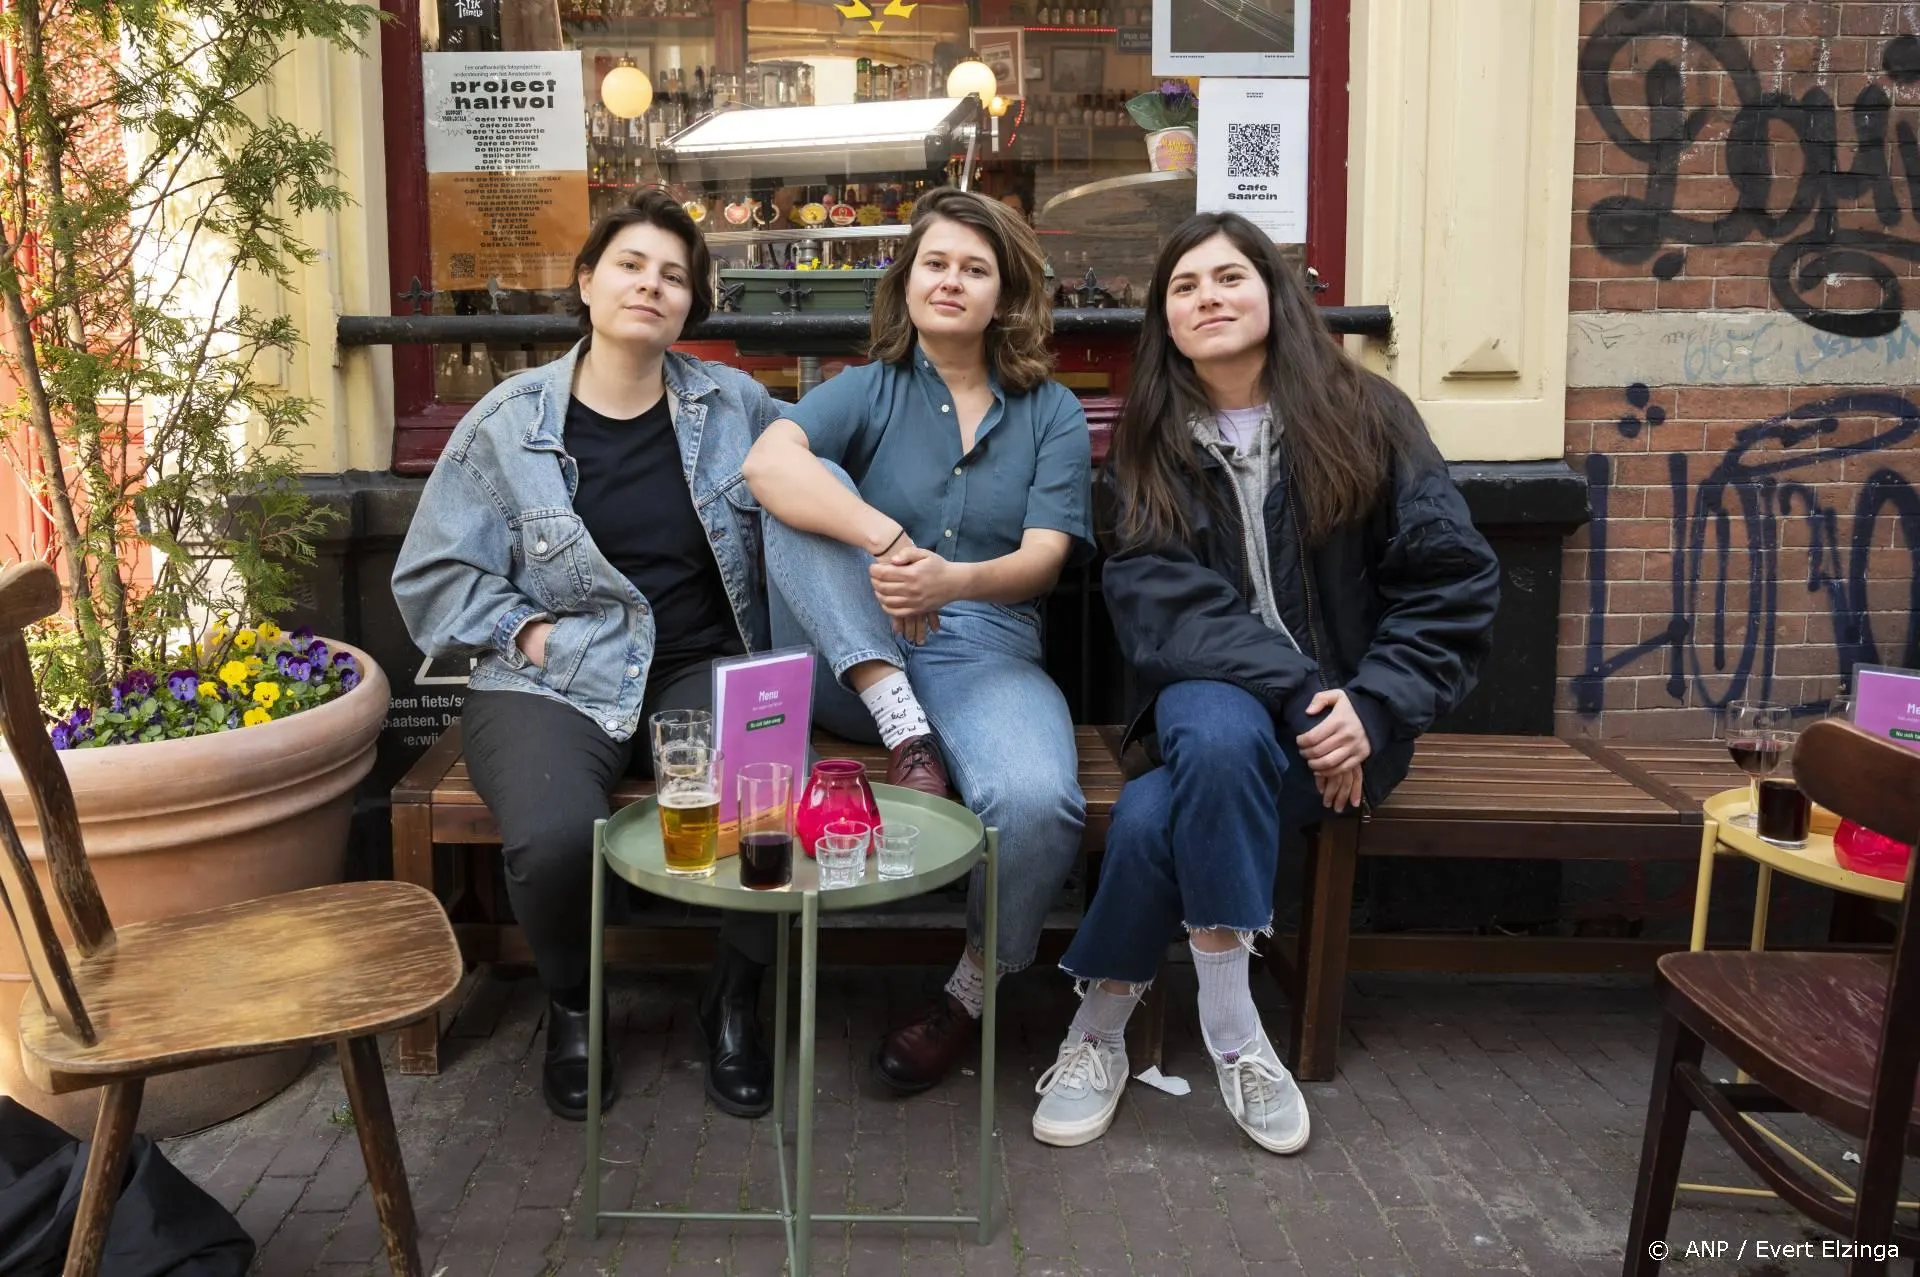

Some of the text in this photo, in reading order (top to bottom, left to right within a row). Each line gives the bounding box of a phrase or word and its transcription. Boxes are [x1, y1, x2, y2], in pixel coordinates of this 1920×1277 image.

[450, 78, 556, 94] project
[454, 95, 554, 109] halfvol
[758, 690, 779, 702] Menu
[442, 713, 462, 727] De
[404, 732, 439, 746] erwij
